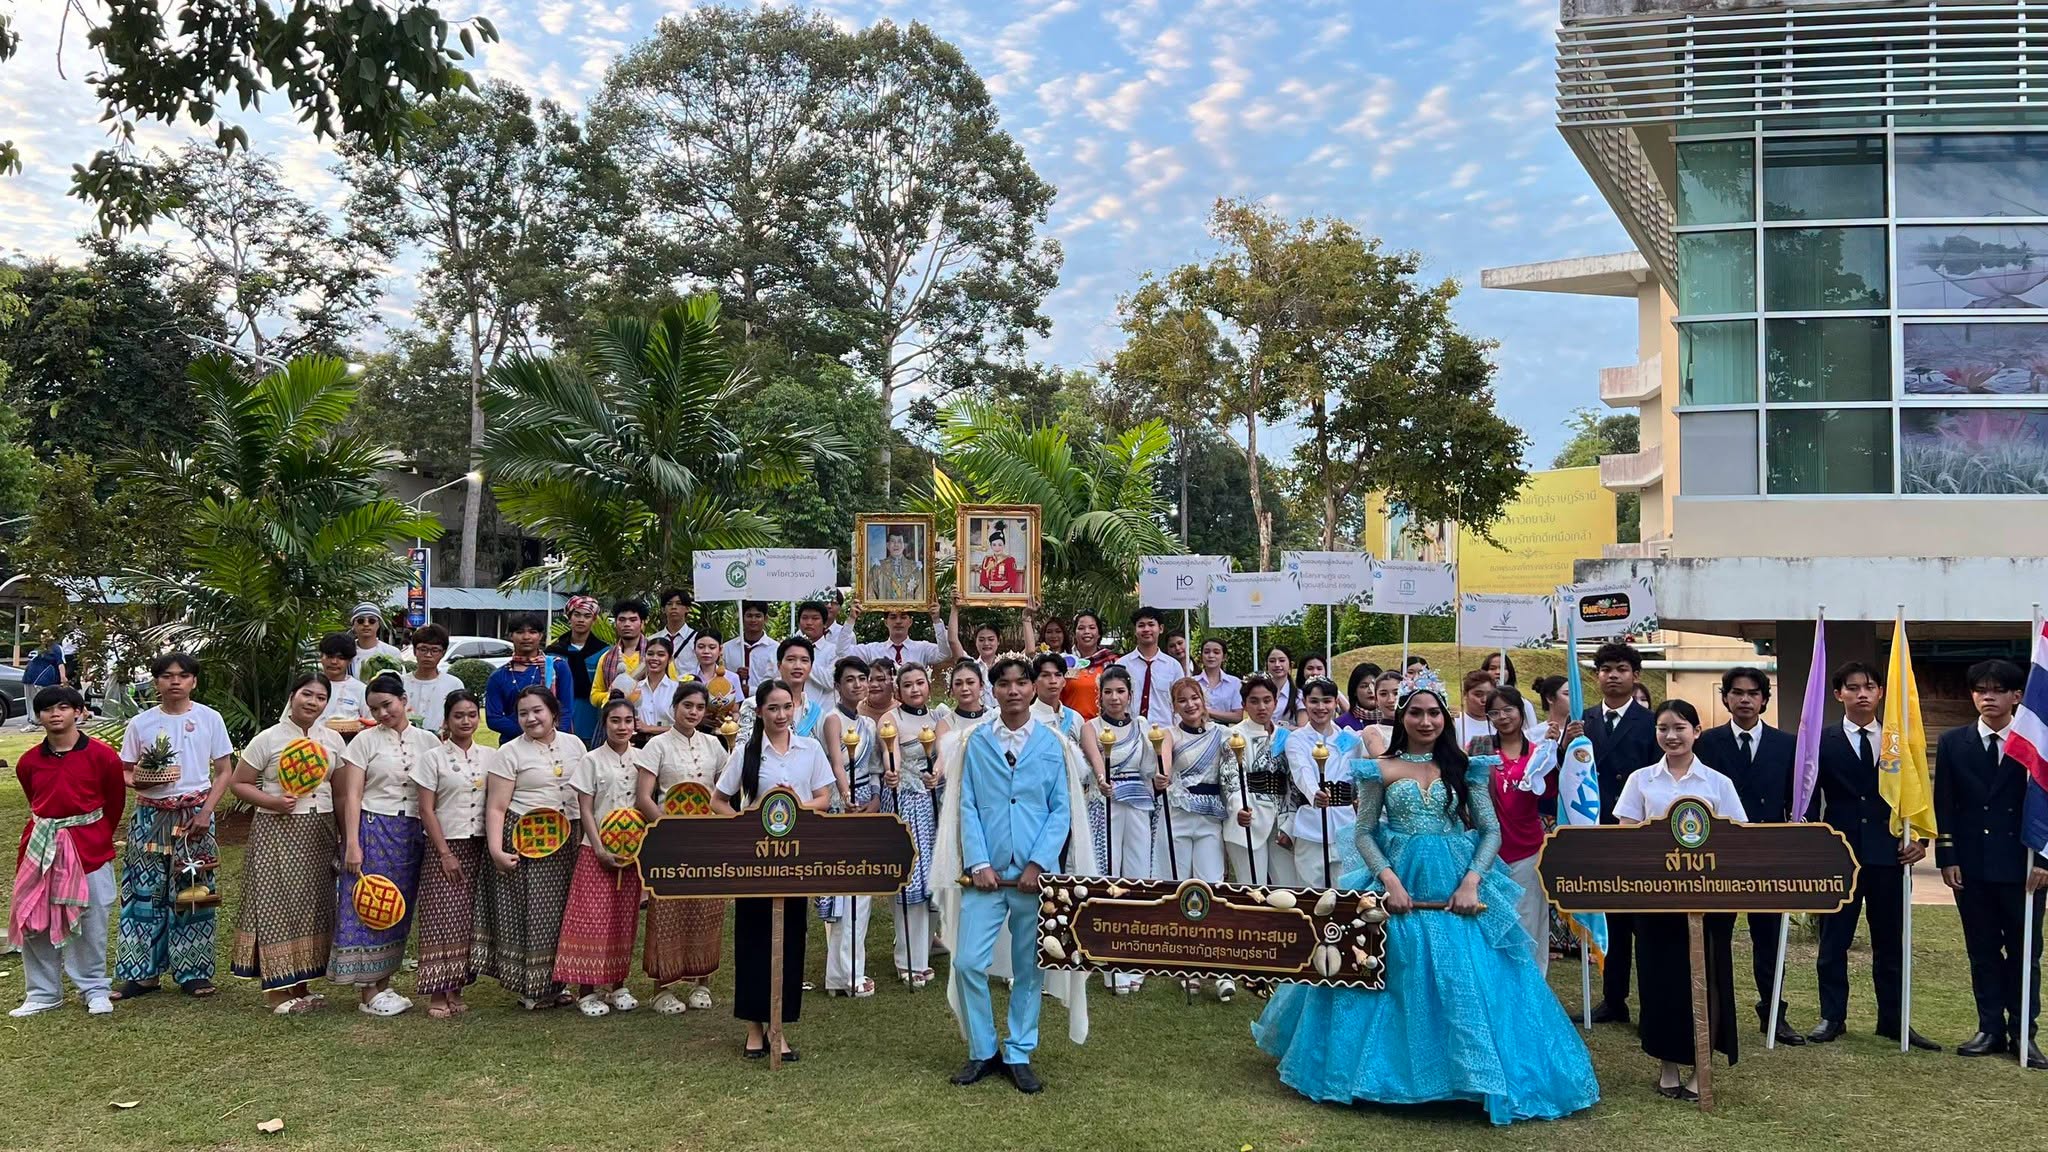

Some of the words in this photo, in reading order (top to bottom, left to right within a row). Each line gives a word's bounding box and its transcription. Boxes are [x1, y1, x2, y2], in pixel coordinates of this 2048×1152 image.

[755, 837, 800, 858] สาขา
[650, 860, 902, 880] การจัดการโรงแรมและธุรกิจเรือสำราญ
[1665, 848, 1716, 872] สาขา
[1556, 875, 1844, 893] ศิลปะการประกอบอาหารไทยและอาหารนานาชาติ
[1092, 918, 1233, 942] วิทยาลัยสหวิทยาการ
[1238, 929, 1297, 948] เกาะสมุย
[1111, 941, 1278, 960] มหาวิทยาลัยราชภัฏสุราษฎร์ธานี
